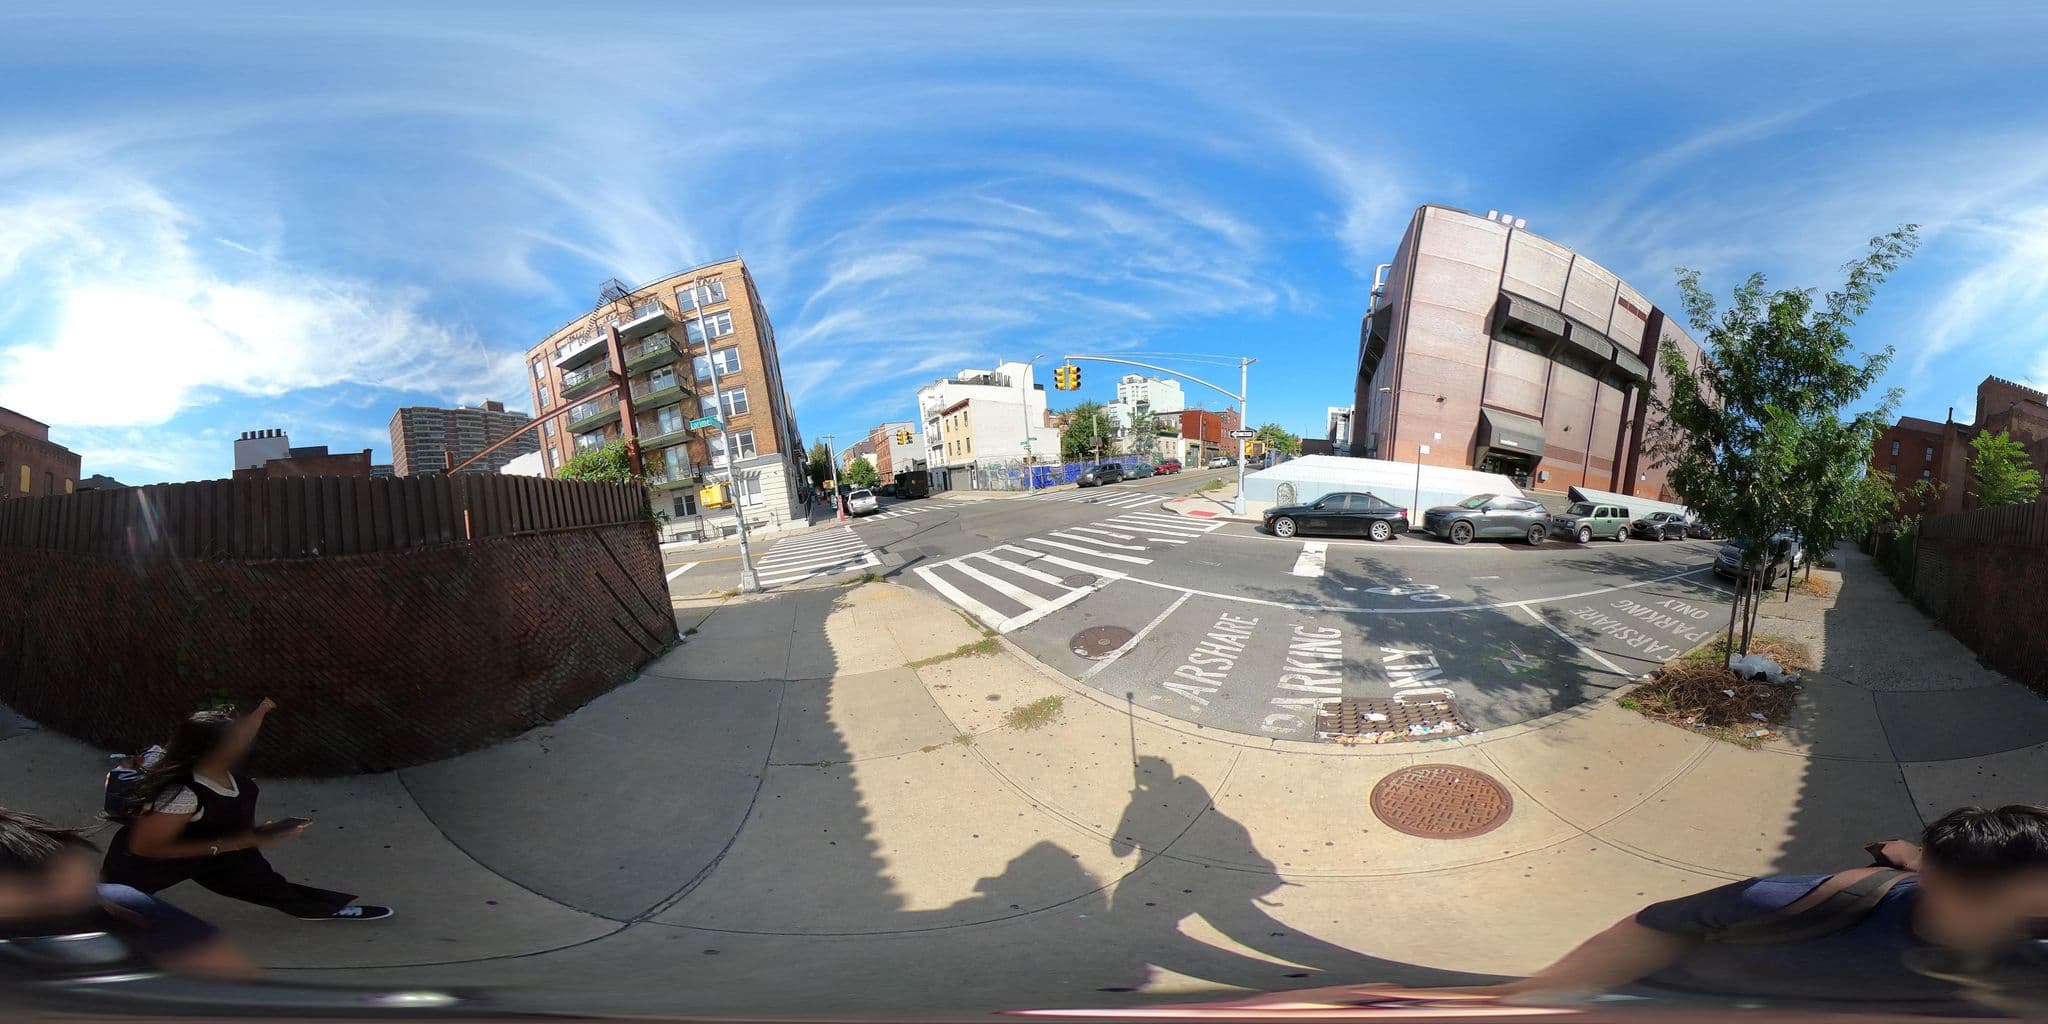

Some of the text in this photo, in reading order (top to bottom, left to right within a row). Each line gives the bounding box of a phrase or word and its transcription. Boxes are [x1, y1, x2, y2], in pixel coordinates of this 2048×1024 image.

[1569, 606, 1681, 662] CARSHARE
[1610, 599, 1709, 643] PARKING
[1656, 599, 1709, 620] ONLY
[1152, 612, 1259, 711] ARSHARE
[1380, 646, 1456, 706] ONLY
